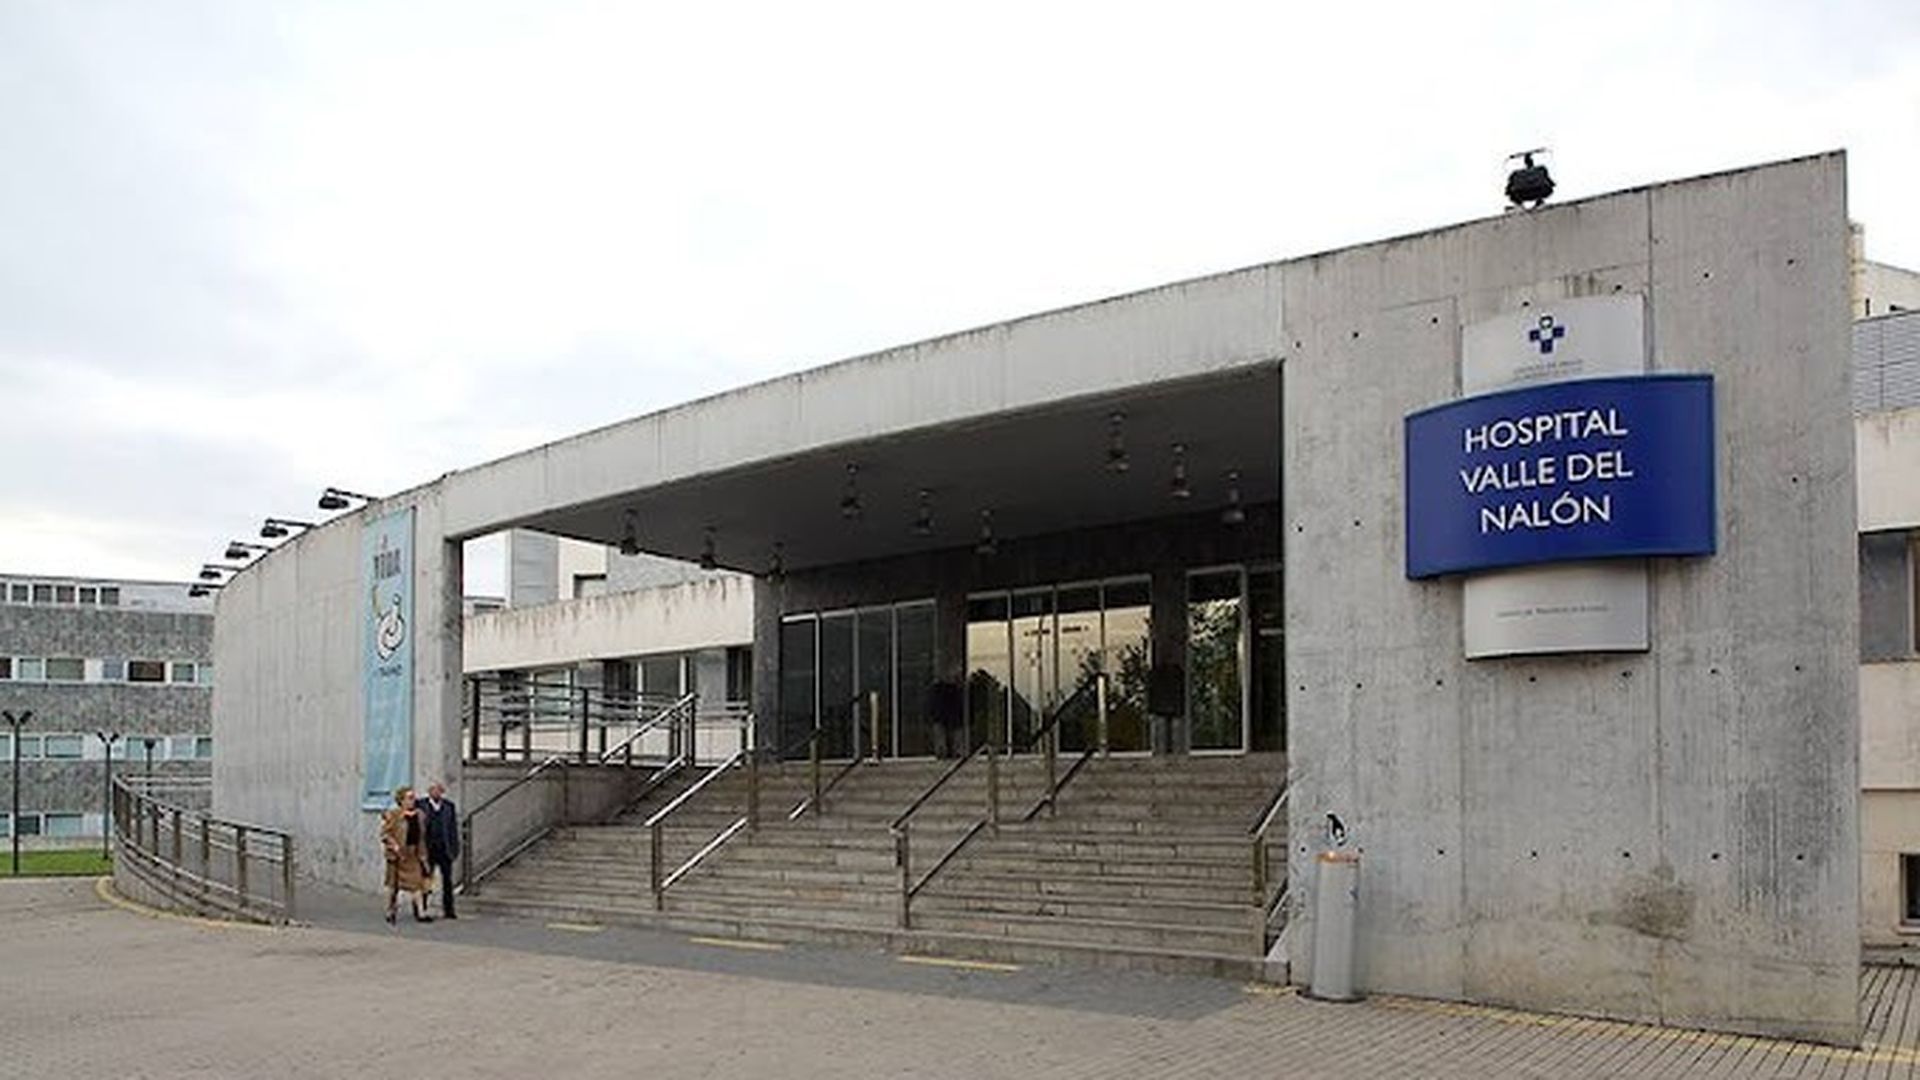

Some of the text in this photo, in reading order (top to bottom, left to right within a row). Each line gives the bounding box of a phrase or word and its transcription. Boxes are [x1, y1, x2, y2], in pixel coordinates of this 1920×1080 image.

[1464, 409, 1628, 453] HOSPITAL
[1460, 451, 1633, 492] VALLE DEL
[1481, 491, 1611, 533] NALÓN
